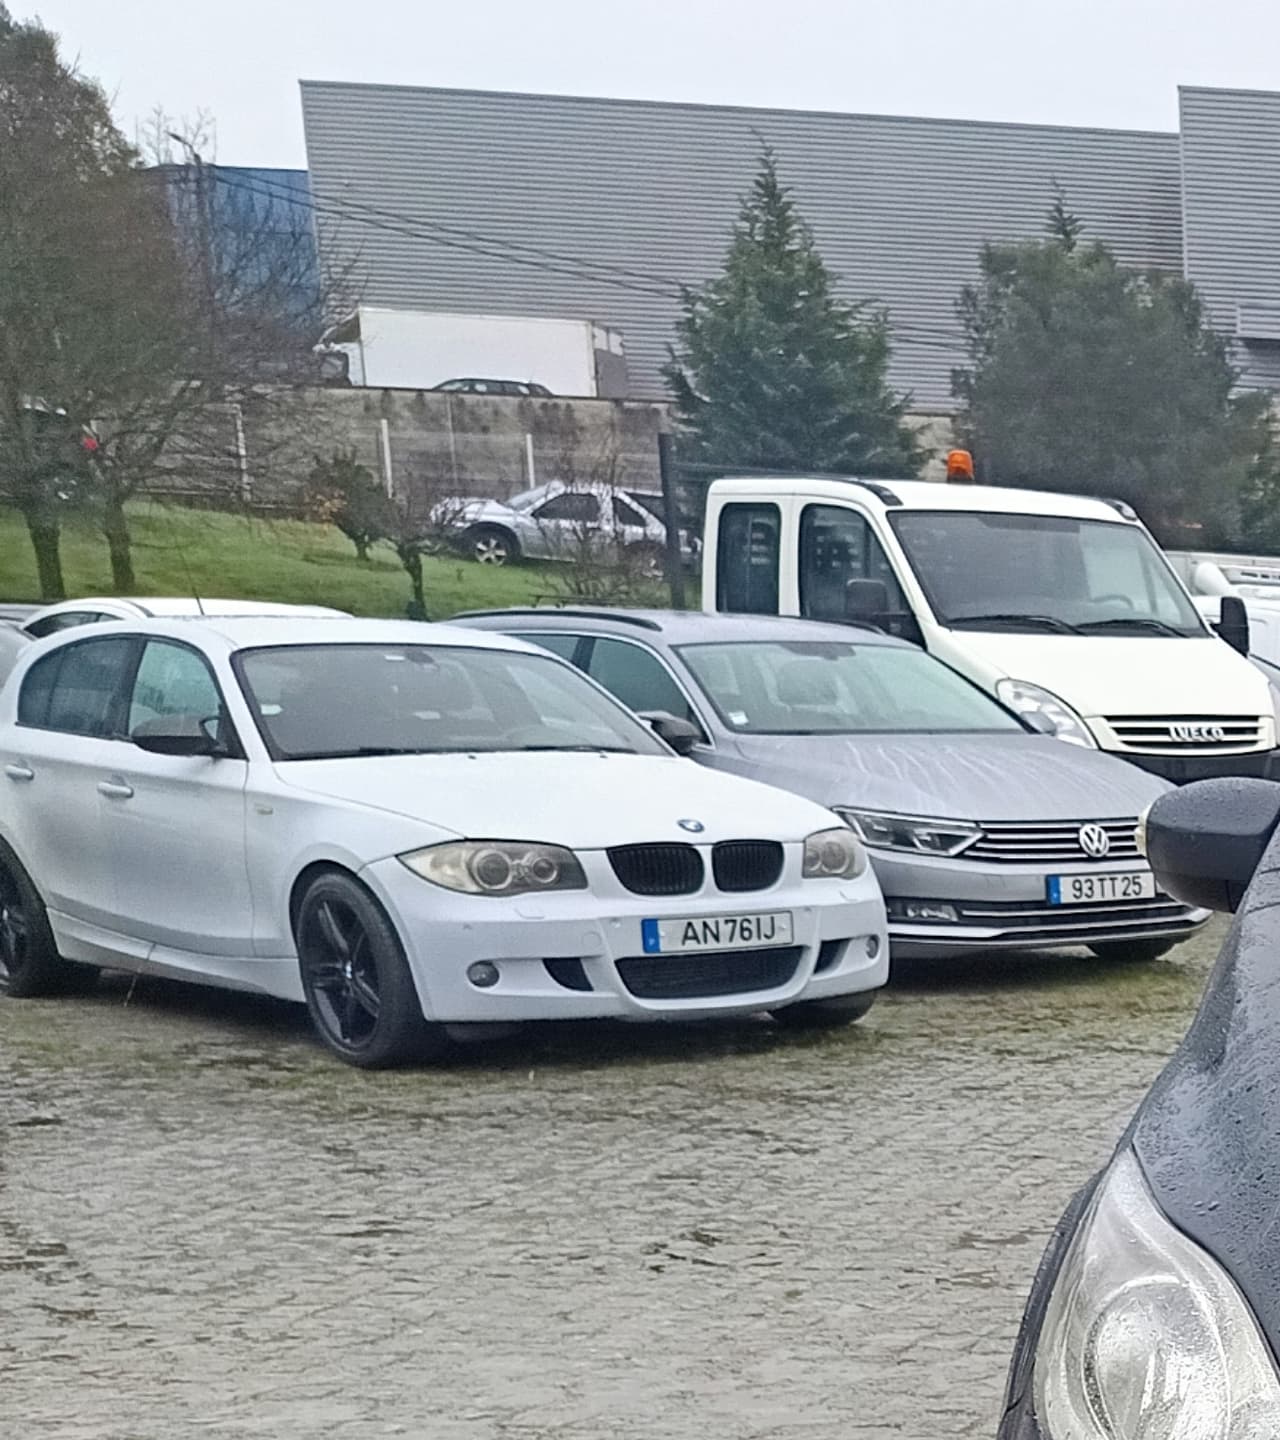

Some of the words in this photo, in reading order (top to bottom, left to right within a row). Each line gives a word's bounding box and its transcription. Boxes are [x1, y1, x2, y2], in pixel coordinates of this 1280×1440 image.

[1169, 721, 1225, 742] IVECO
[1071, 876, 1143, 900] 93TT25
[681, 916, 776, 946] AN76IJ
